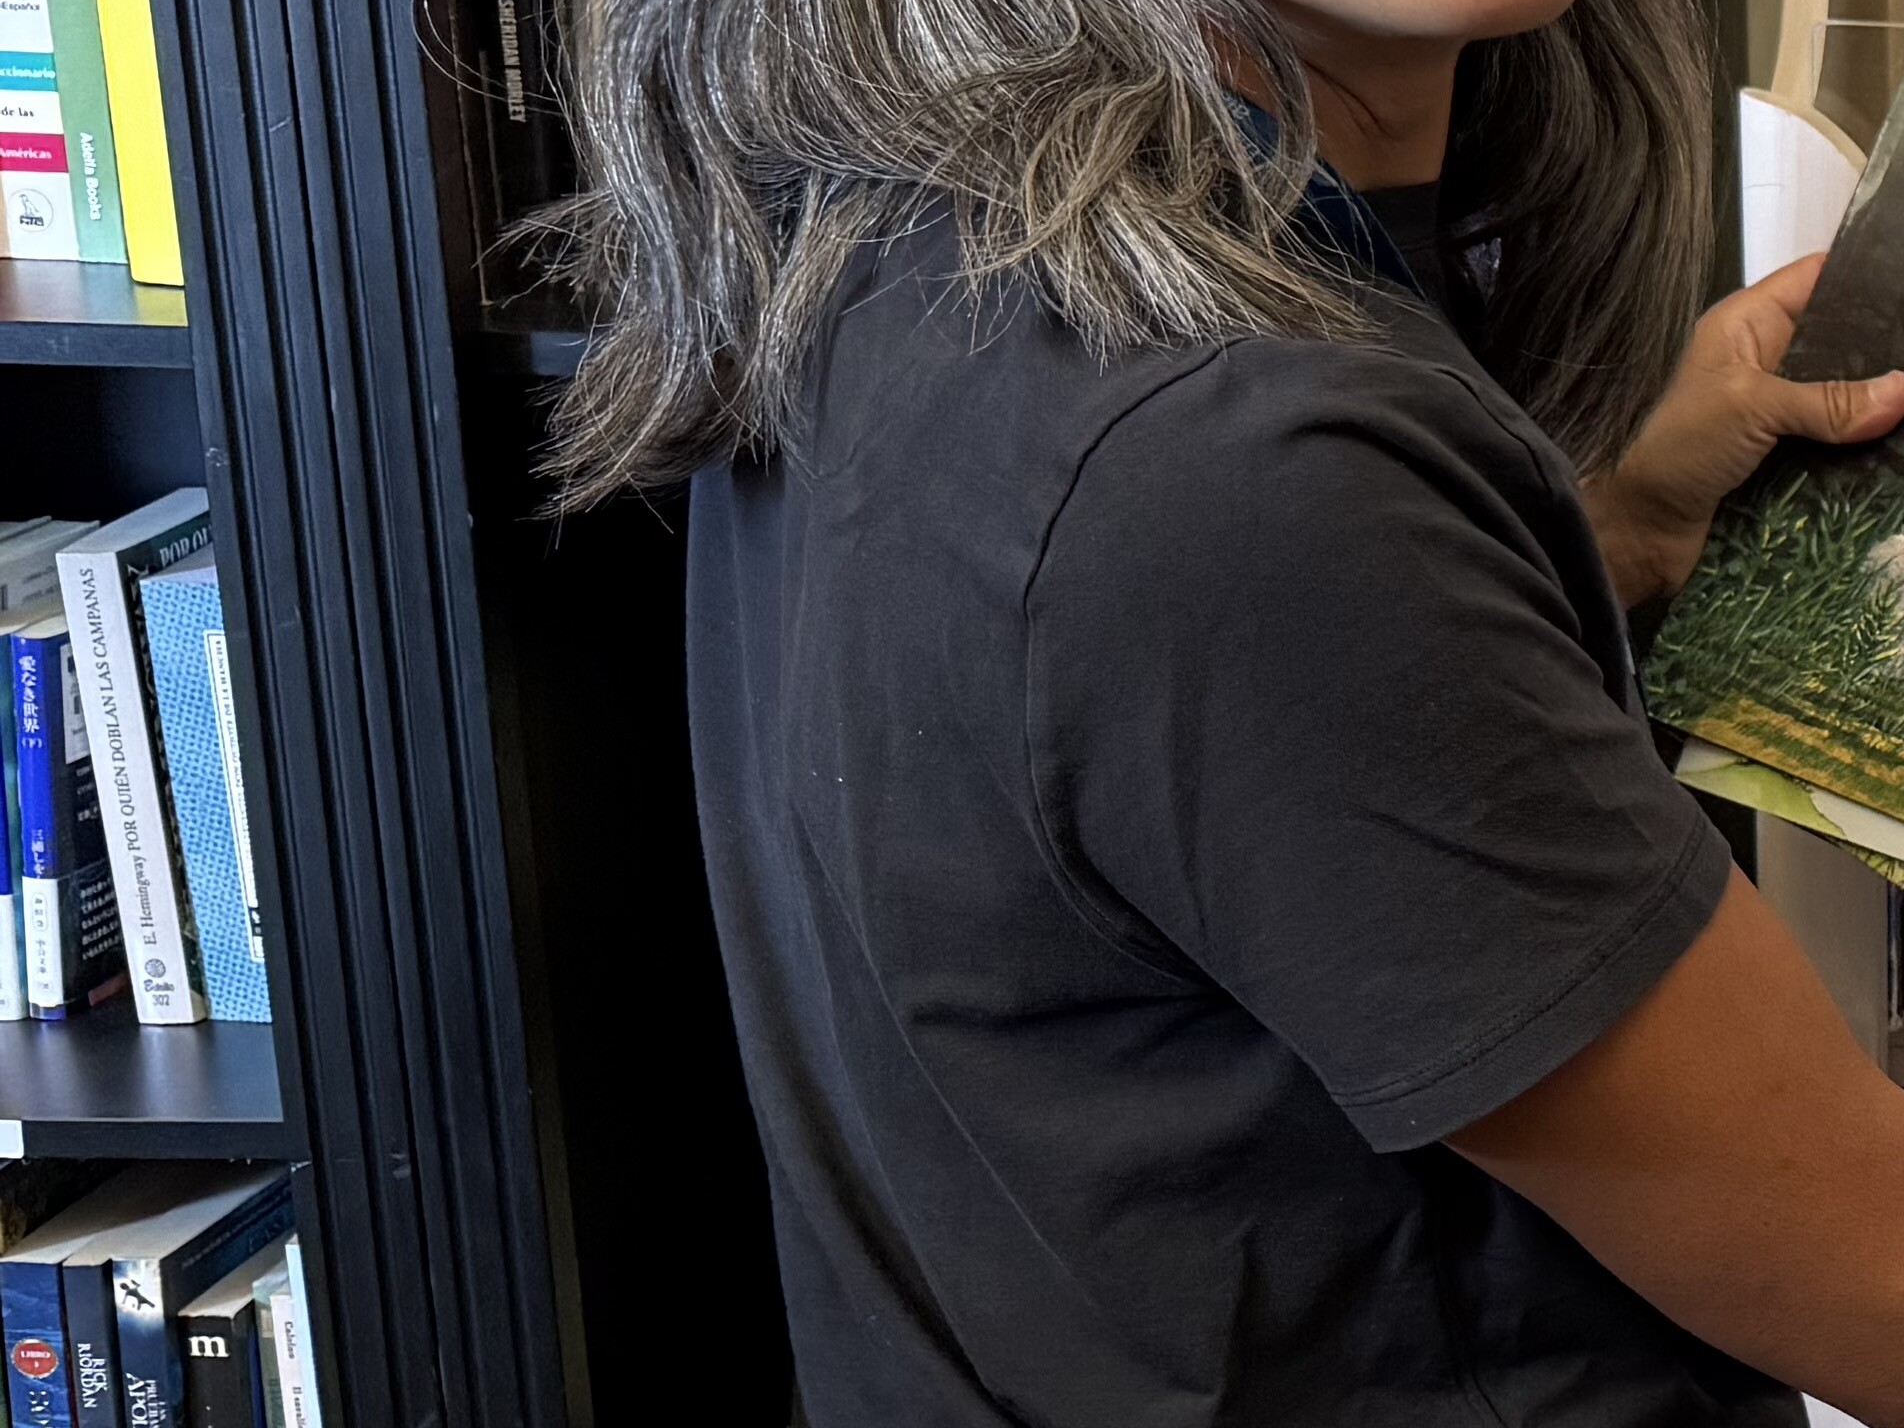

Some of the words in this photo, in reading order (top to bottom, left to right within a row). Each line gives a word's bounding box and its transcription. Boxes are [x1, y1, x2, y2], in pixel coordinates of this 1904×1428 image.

[79, 566, 109, 668] CAMPANAS
[99, 672, 119, 706] LAS
[105, 708, 129, 764] DOBLAN
[116, 763, 137, 819] QUIÉN
[124, 820, 141, 851] POR
[128, 853, 156, 927] Hemingway
[144, 929, 158, 946] E.
